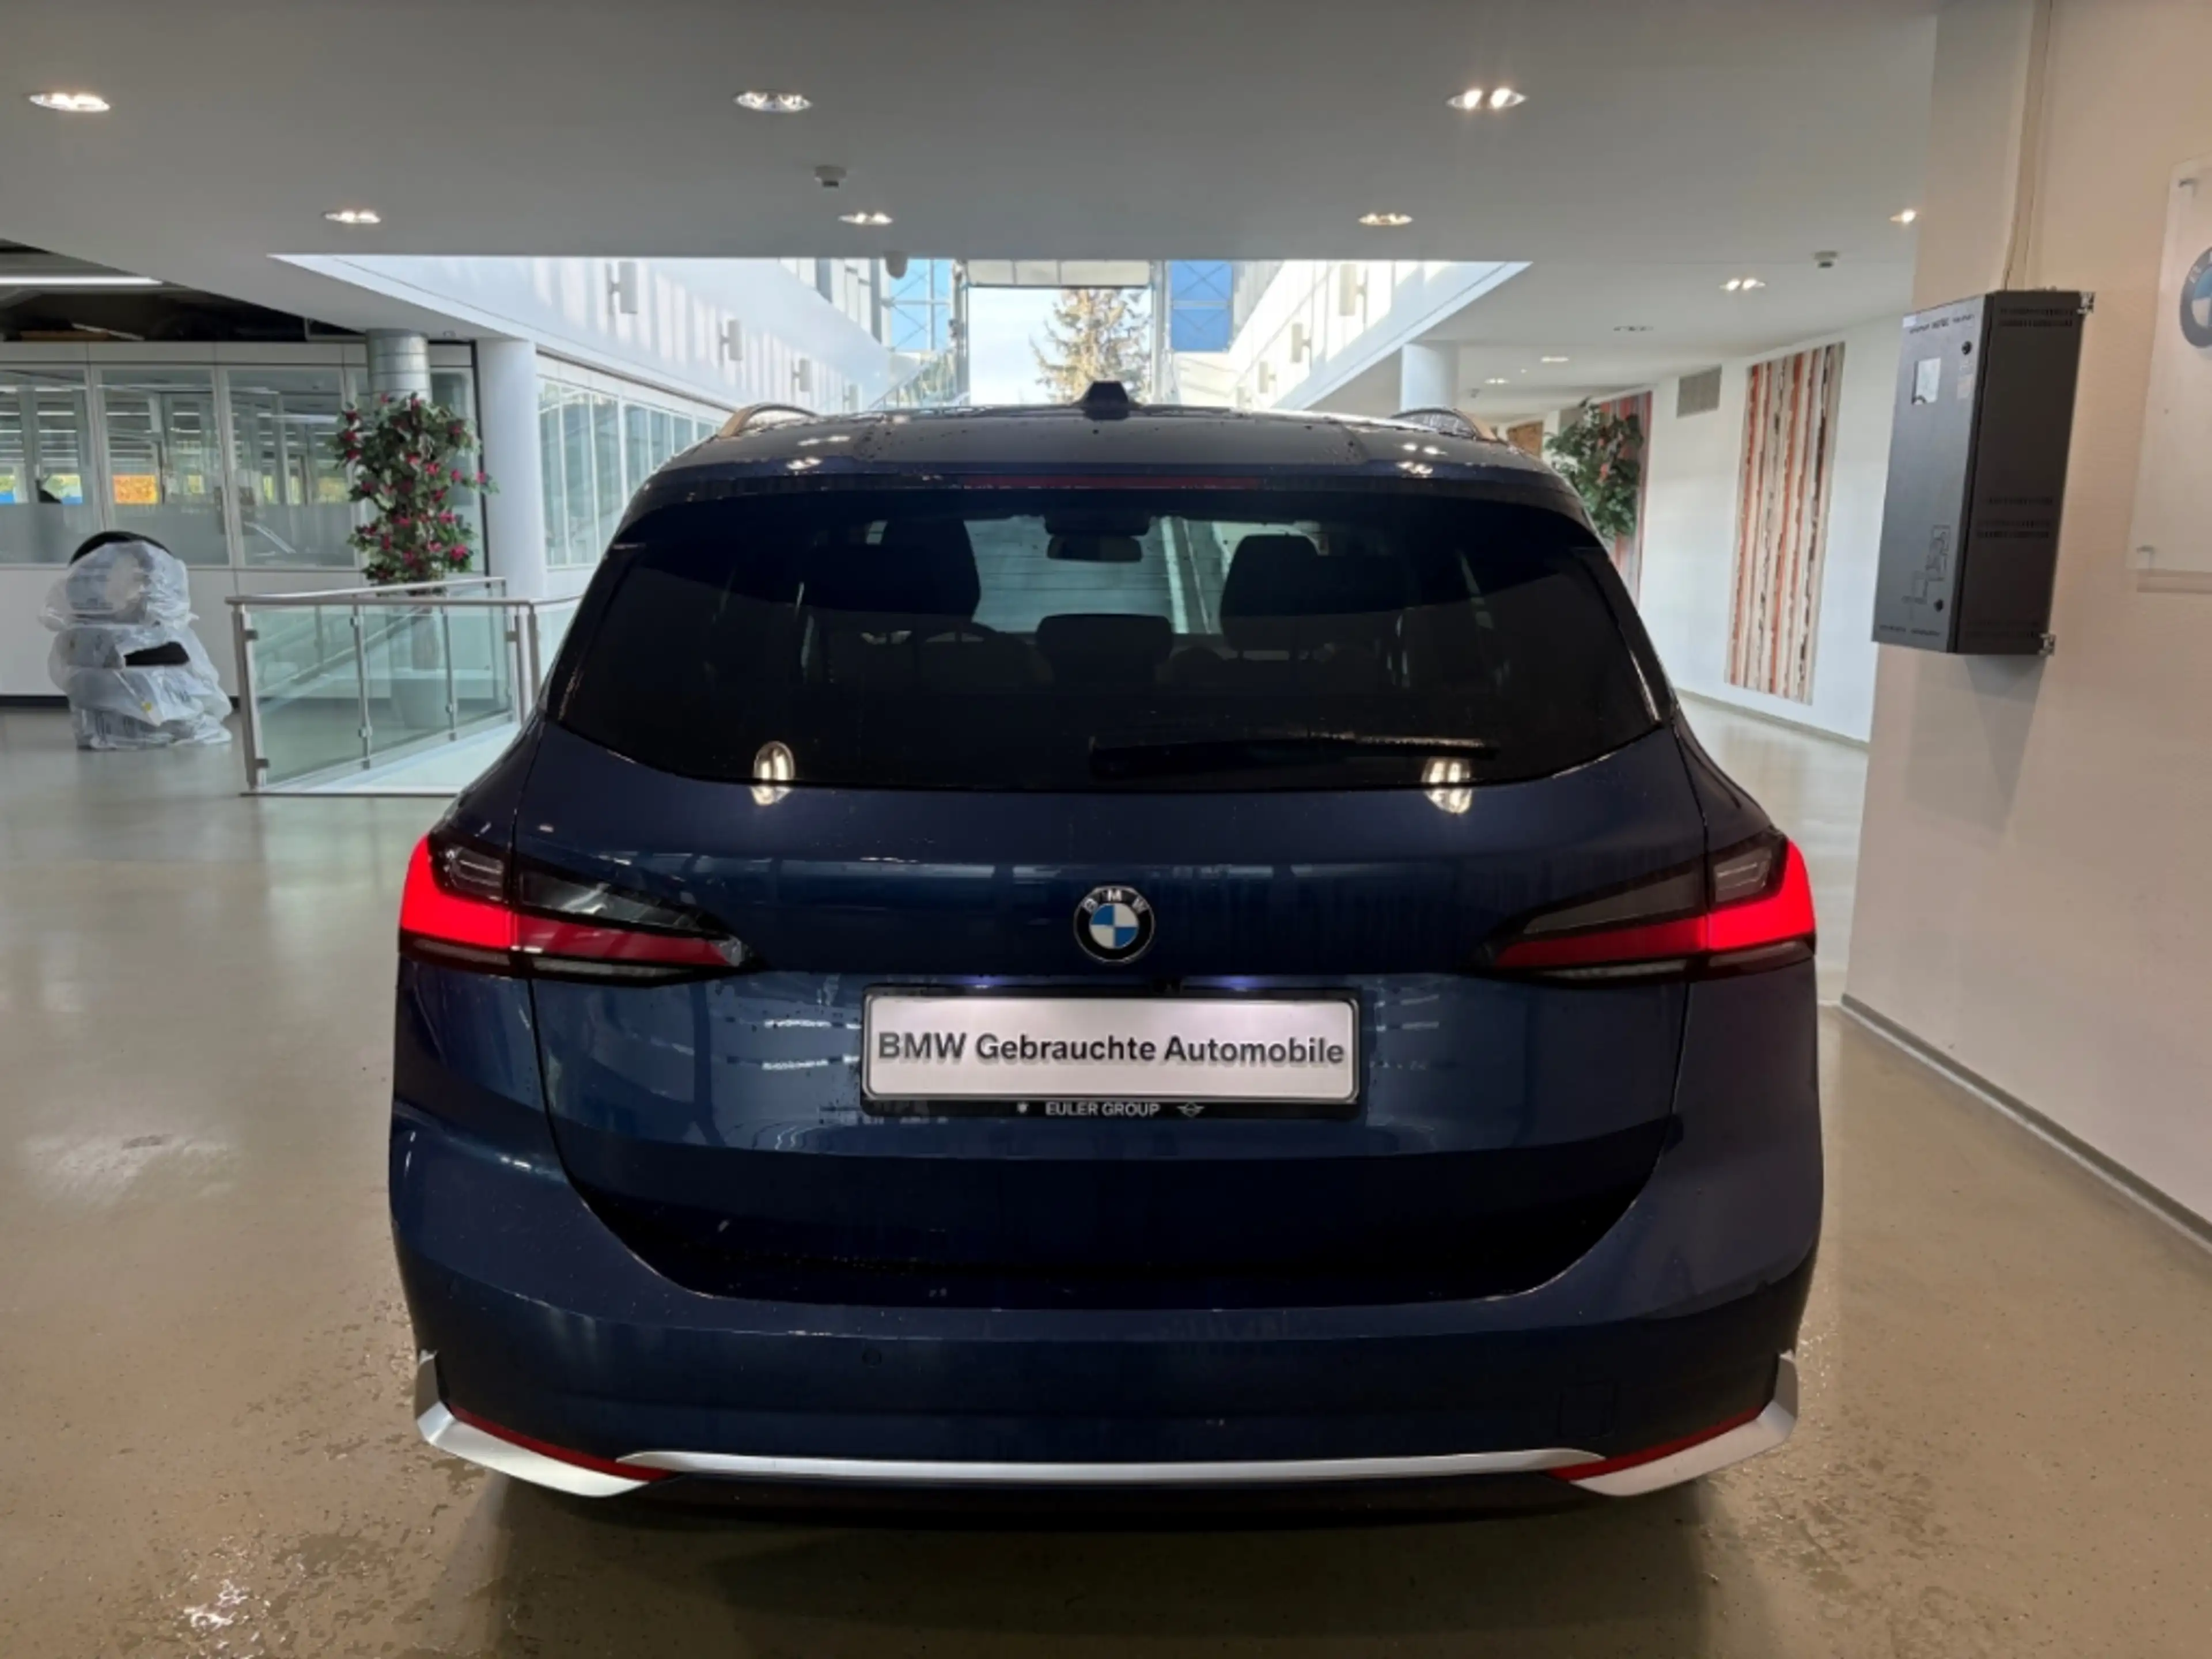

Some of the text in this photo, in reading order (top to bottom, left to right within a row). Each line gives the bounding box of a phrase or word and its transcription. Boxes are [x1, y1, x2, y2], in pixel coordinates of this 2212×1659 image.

[1083, 889, 1150, 915] BMW
[878, 1032, 1345, 1064] BMW Gebrauchte Automobile
[1046, 1101, 1161, 1117] EULER GROUP
